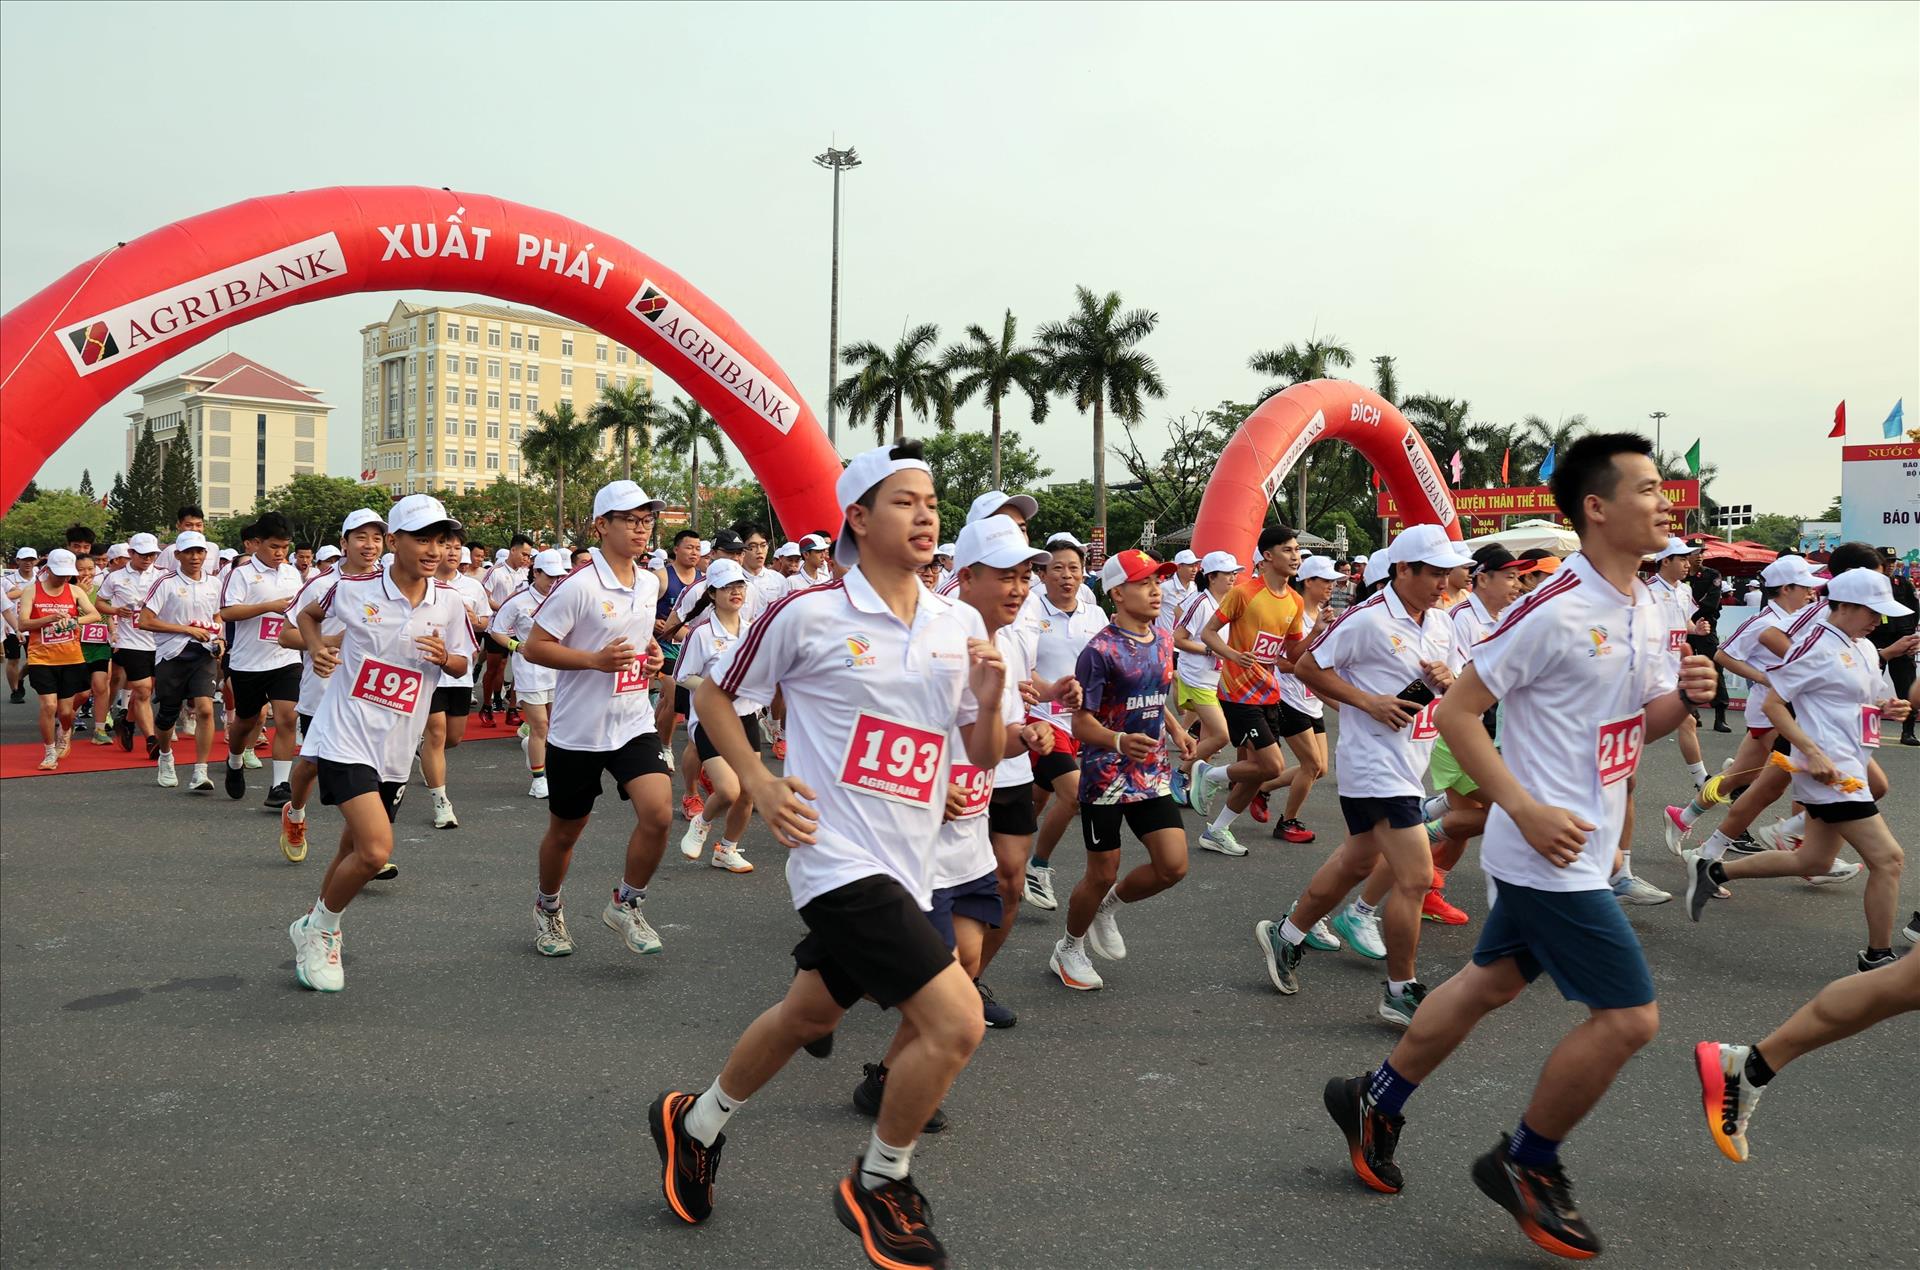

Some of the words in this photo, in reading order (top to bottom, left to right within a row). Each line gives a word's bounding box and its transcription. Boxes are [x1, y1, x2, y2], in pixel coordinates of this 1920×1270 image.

[377, 206, 492, 262] XUẤT
[516, 242, 614, 290] PHÁT
[127, 249, 337, 350] AGRIBANK
[658, 317, 790, 427] AGRIBANK
[1350, 398, 1381, 427] ĐÍCH
[1868, 446, 1912, 457] NƯỚC
[1410, 450, 1451, 522] AGRIBANK
[1456, 494, 1486, 512] LUYỆN
[1488, 493, 1514, 509] THÂN
[1517, 489, 1535, 507] THỂ
[1537, 494, 1556, 506] THE
[1883, 509, 1910, 524] BẢO
[88, 627, 104, 638] 28
[134, 613, 140, 624] 2
[363, 668, 418, 702] 192
[362, 693, 405, 710] AGRIBANK
[858, 729, 939, 783] 193
[1600, 725, 1642, 769] 219
[858, 776, 921, 798] AGRIBANK
[955, 771, 994, 801] 199
[1721, 1072, 1741, 1136] NITRO
